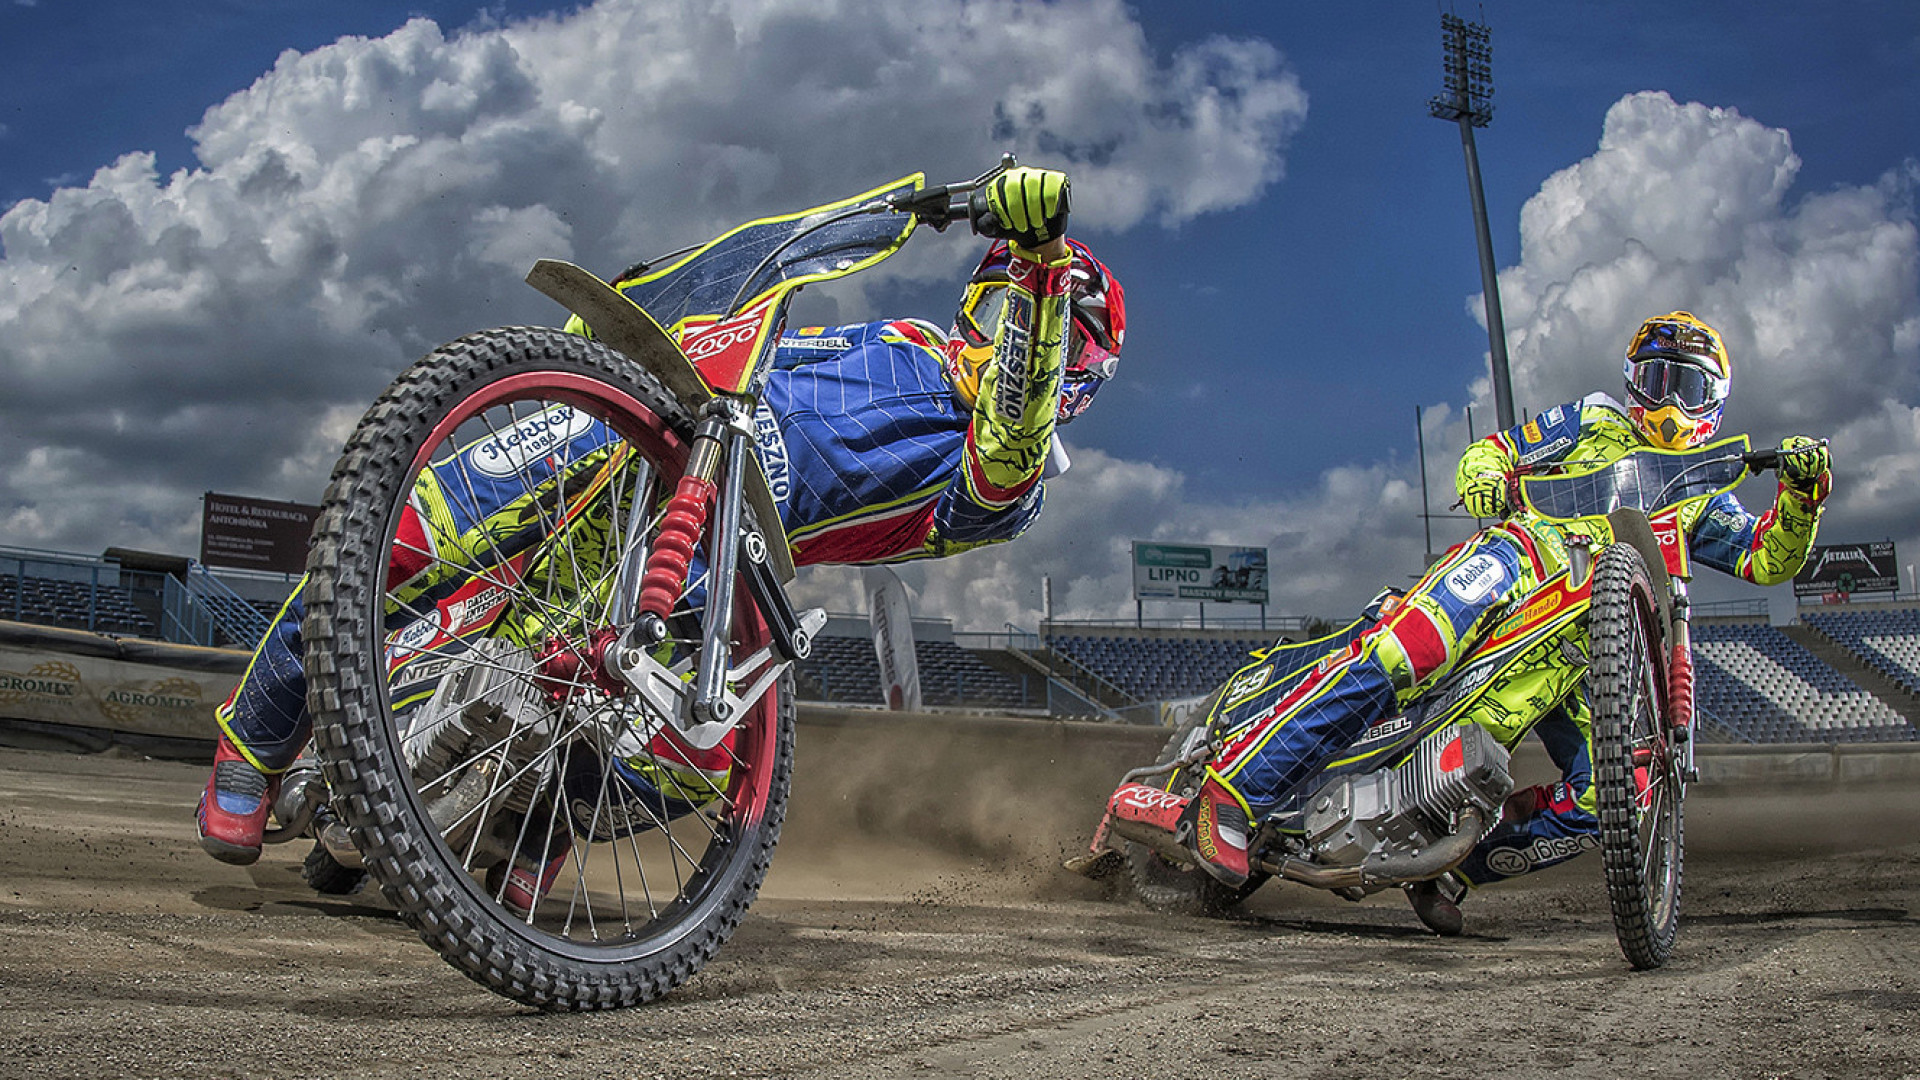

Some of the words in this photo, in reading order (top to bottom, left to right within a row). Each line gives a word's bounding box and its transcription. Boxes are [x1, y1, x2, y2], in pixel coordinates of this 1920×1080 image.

[210, 502, 240, 514] HOTEL
[241, 505, 249, 514] &
[251, 507, 308, 522] RESTAURACJA
[1149, 568, 1200, 582] LIPNO
[0, 677, 74, 696] GROMIX
[106, 690, 196, 709] AGROMIX
[1366, 717, 1412, 741] BELL
